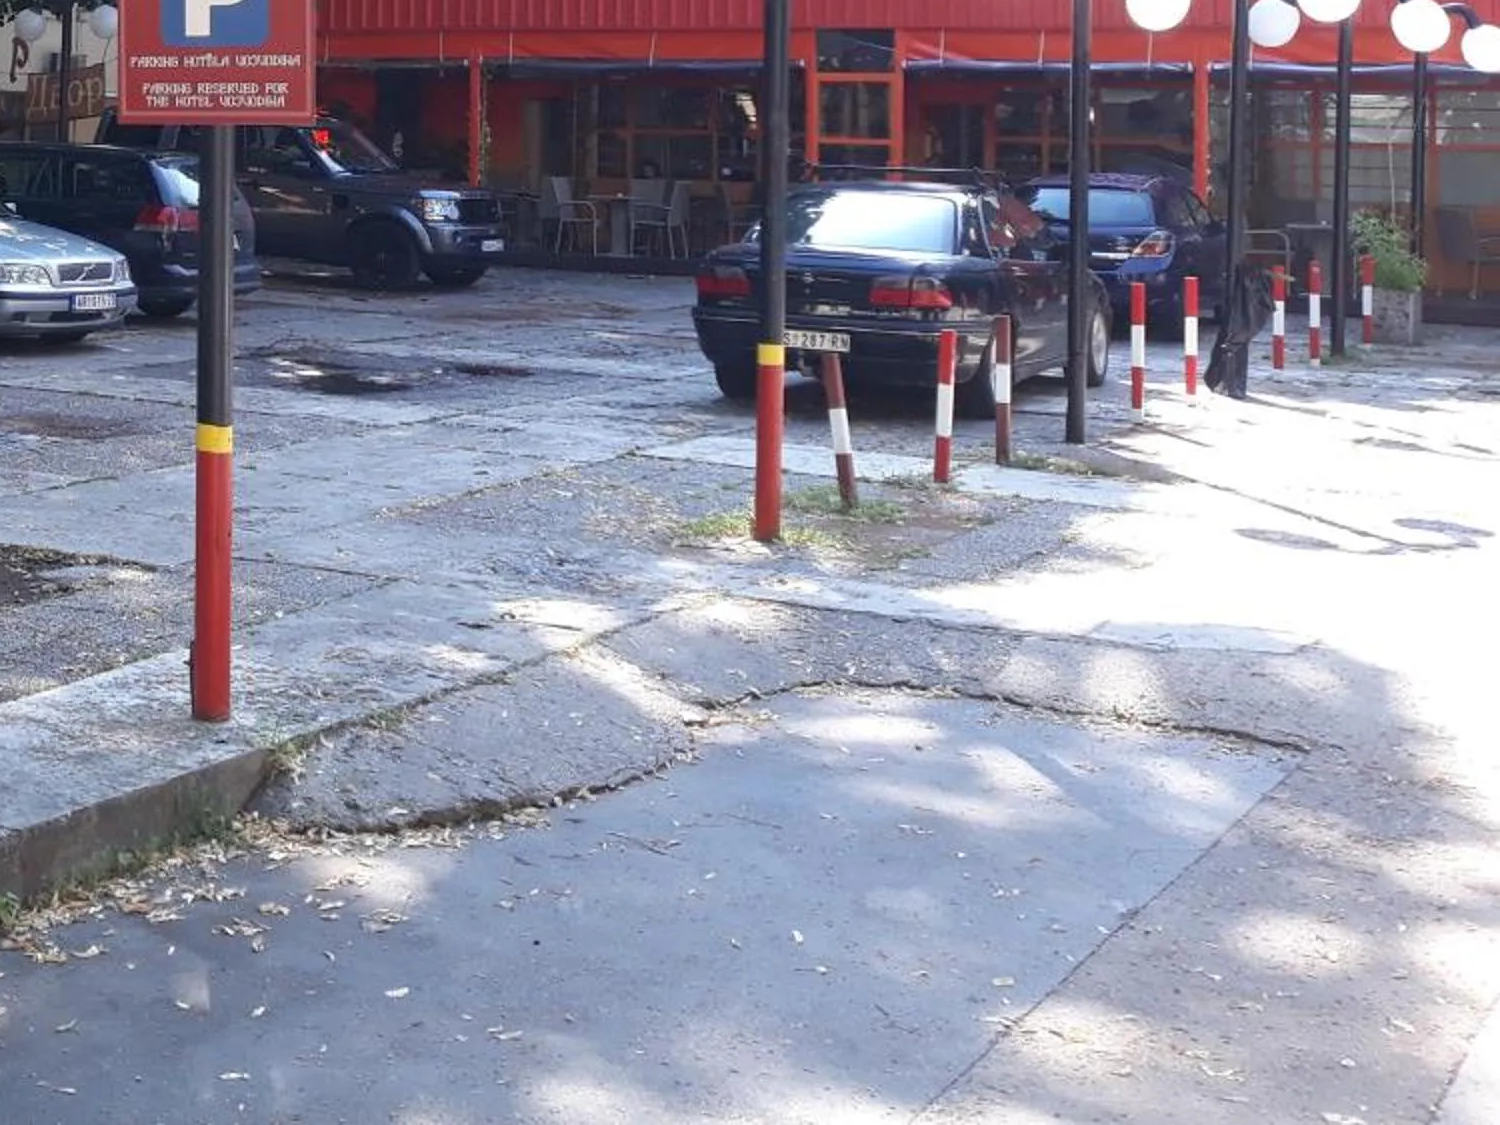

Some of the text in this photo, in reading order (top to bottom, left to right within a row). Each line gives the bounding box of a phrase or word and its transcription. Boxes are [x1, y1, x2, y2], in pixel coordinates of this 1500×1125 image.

[197, 82, 260, 94] RESERVED
[265, 82, 289, 94] FOR
[146, 96, 170, 108] THE
[175, 95, 215, 108] HOTEL
